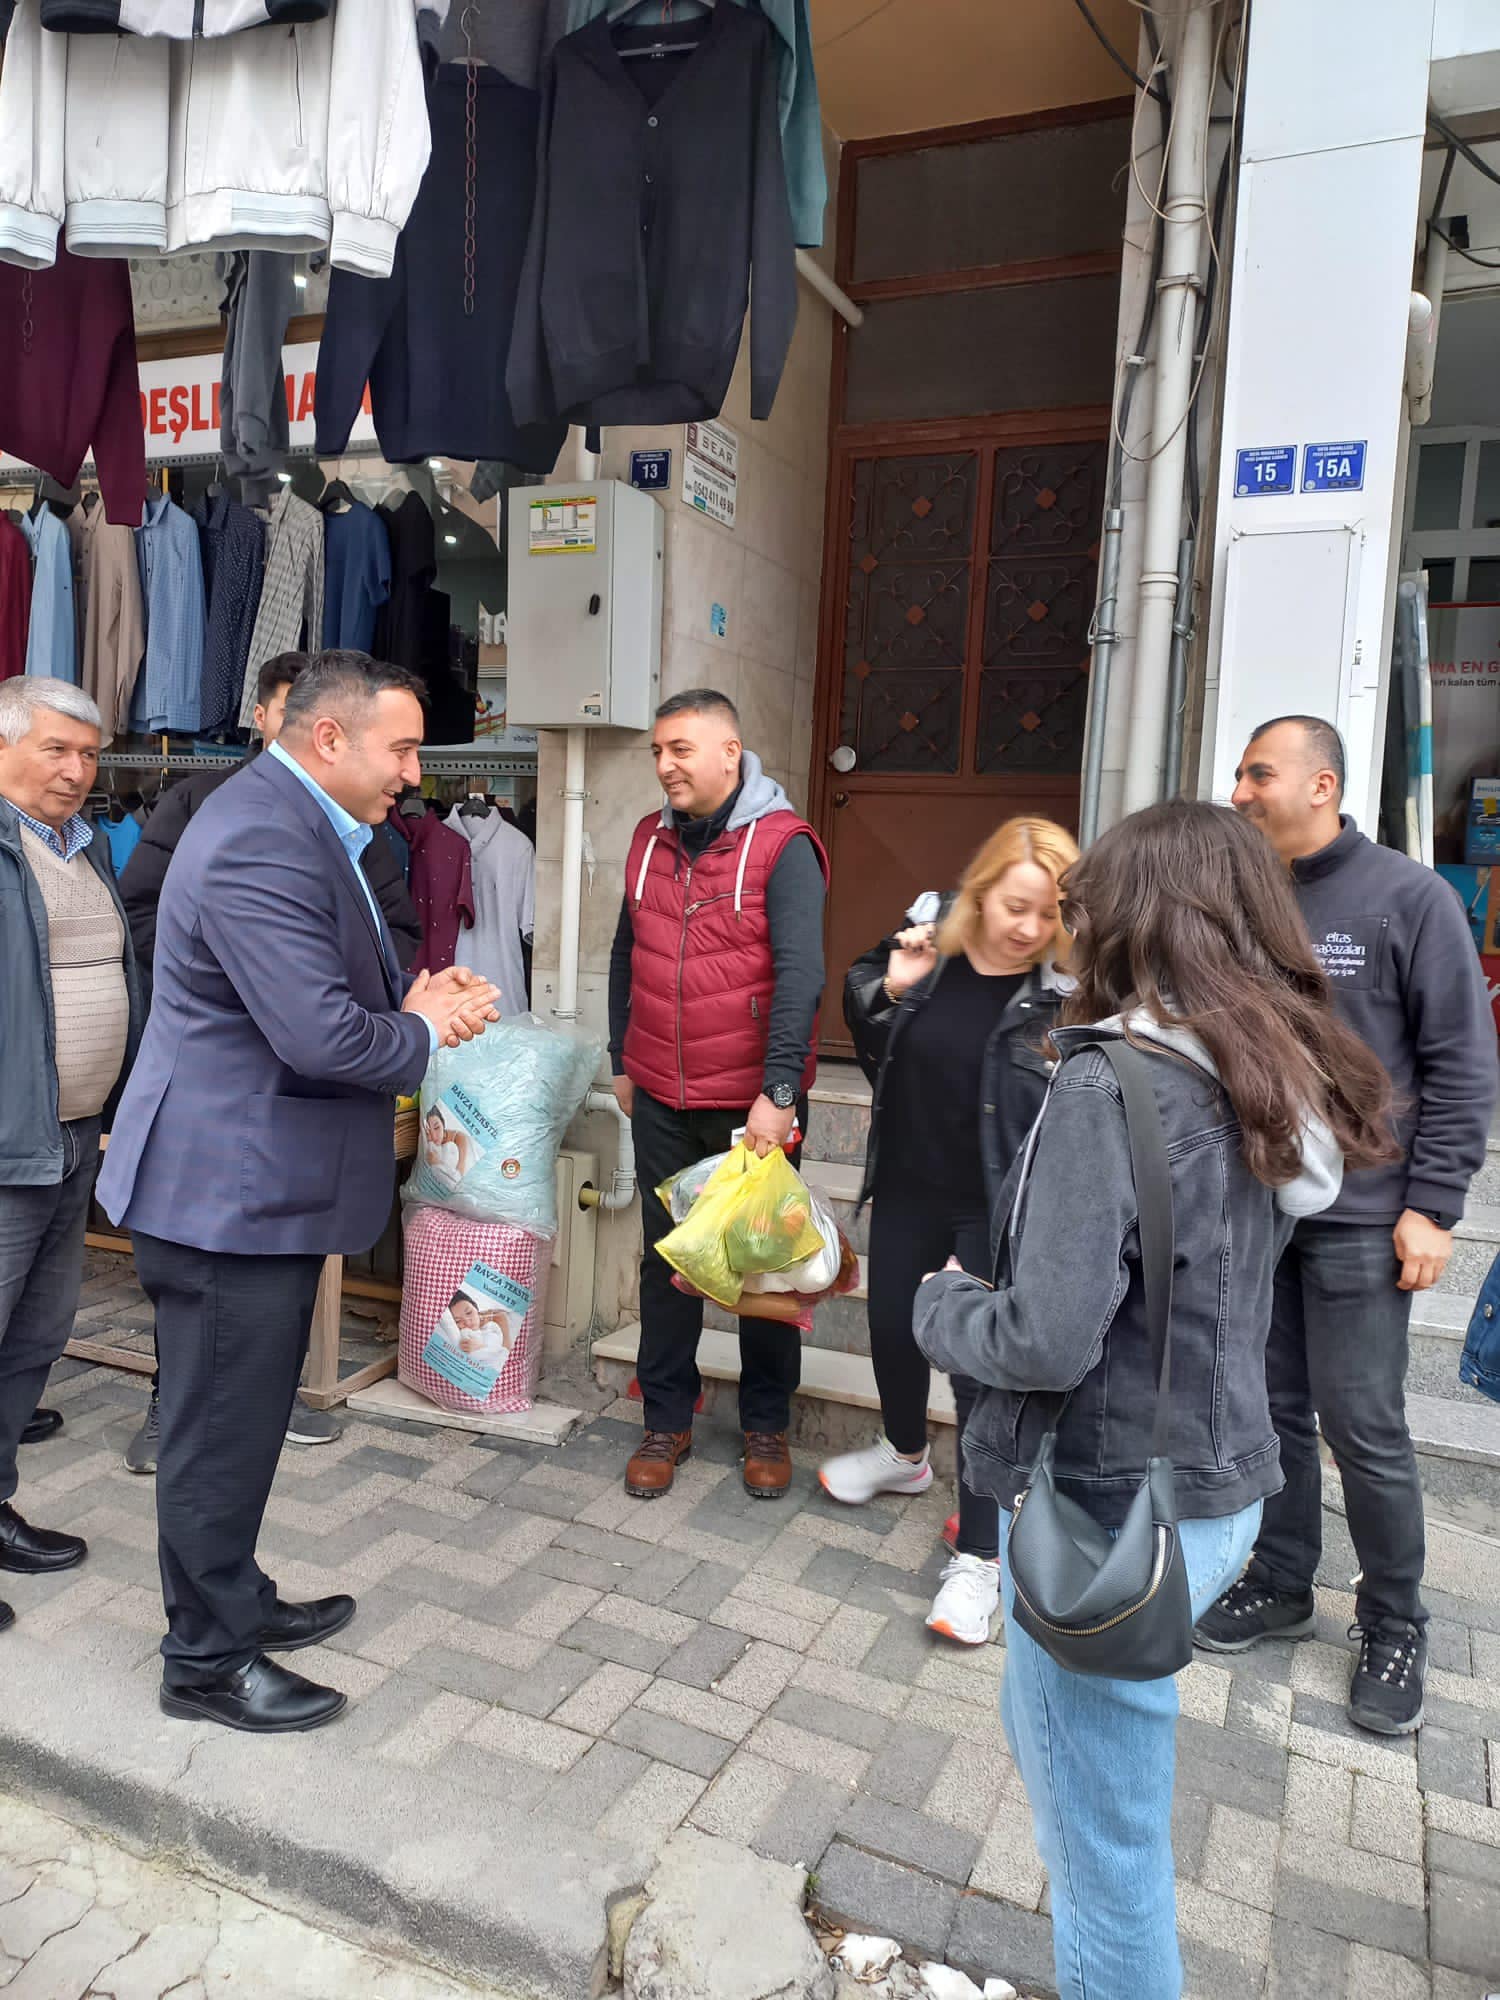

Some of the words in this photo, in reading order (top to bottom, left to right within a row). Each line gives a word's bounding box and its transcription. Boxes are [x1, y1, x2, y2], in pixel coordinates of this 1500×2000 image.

[642, 463, 658, 480] 13
[1254, 463, 1277, 482] 15
[1315, 458, 1351, 478] 15A
[1461, 661, 1483, 673] EN
[451, 1084, 473, 1111] RAVZA
[473, 1264, 502, 1286] RAVZA
